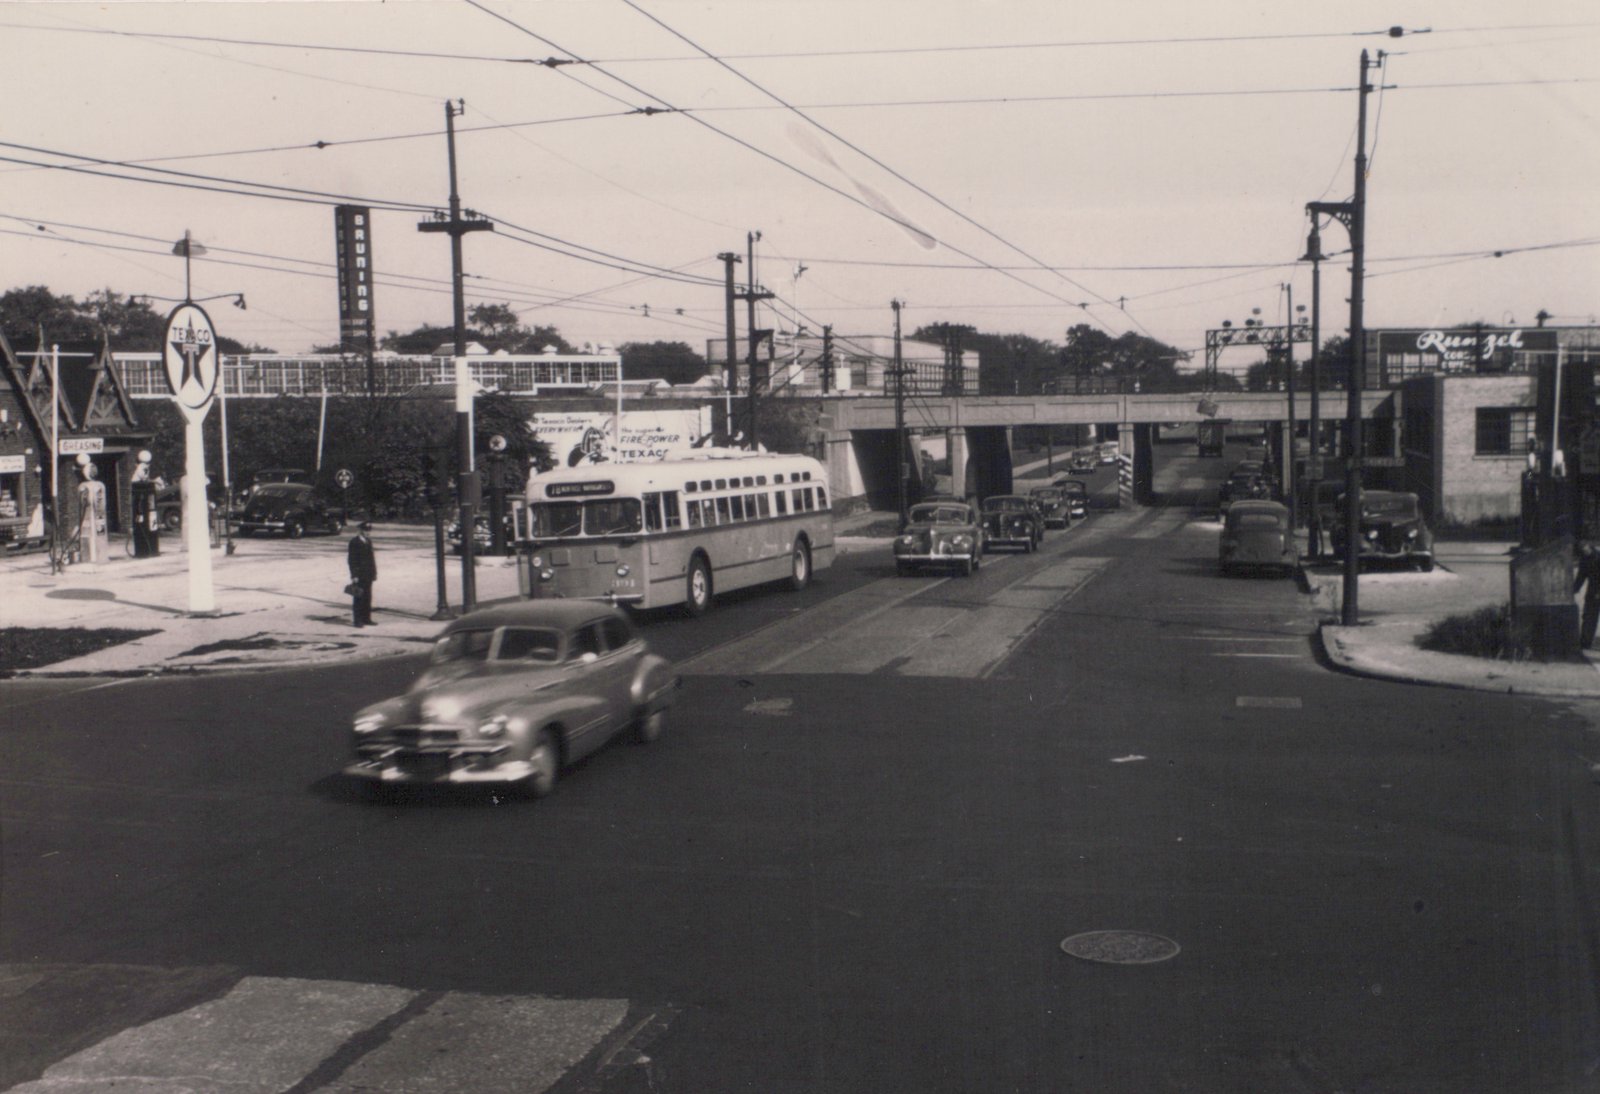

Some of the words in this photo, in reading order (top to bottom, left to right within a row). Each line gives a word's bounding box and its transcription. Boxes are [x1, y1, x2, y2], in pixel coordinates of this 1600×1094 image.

[353, 214, 369, 312] BRUNING
[172, 327, 210, 342] TEXACO
[536, 426, 583, 434] EVERYWHER
[620, 434, 680, 444] FIRE-POWER
[62, 440, 102, 451] GREASING
